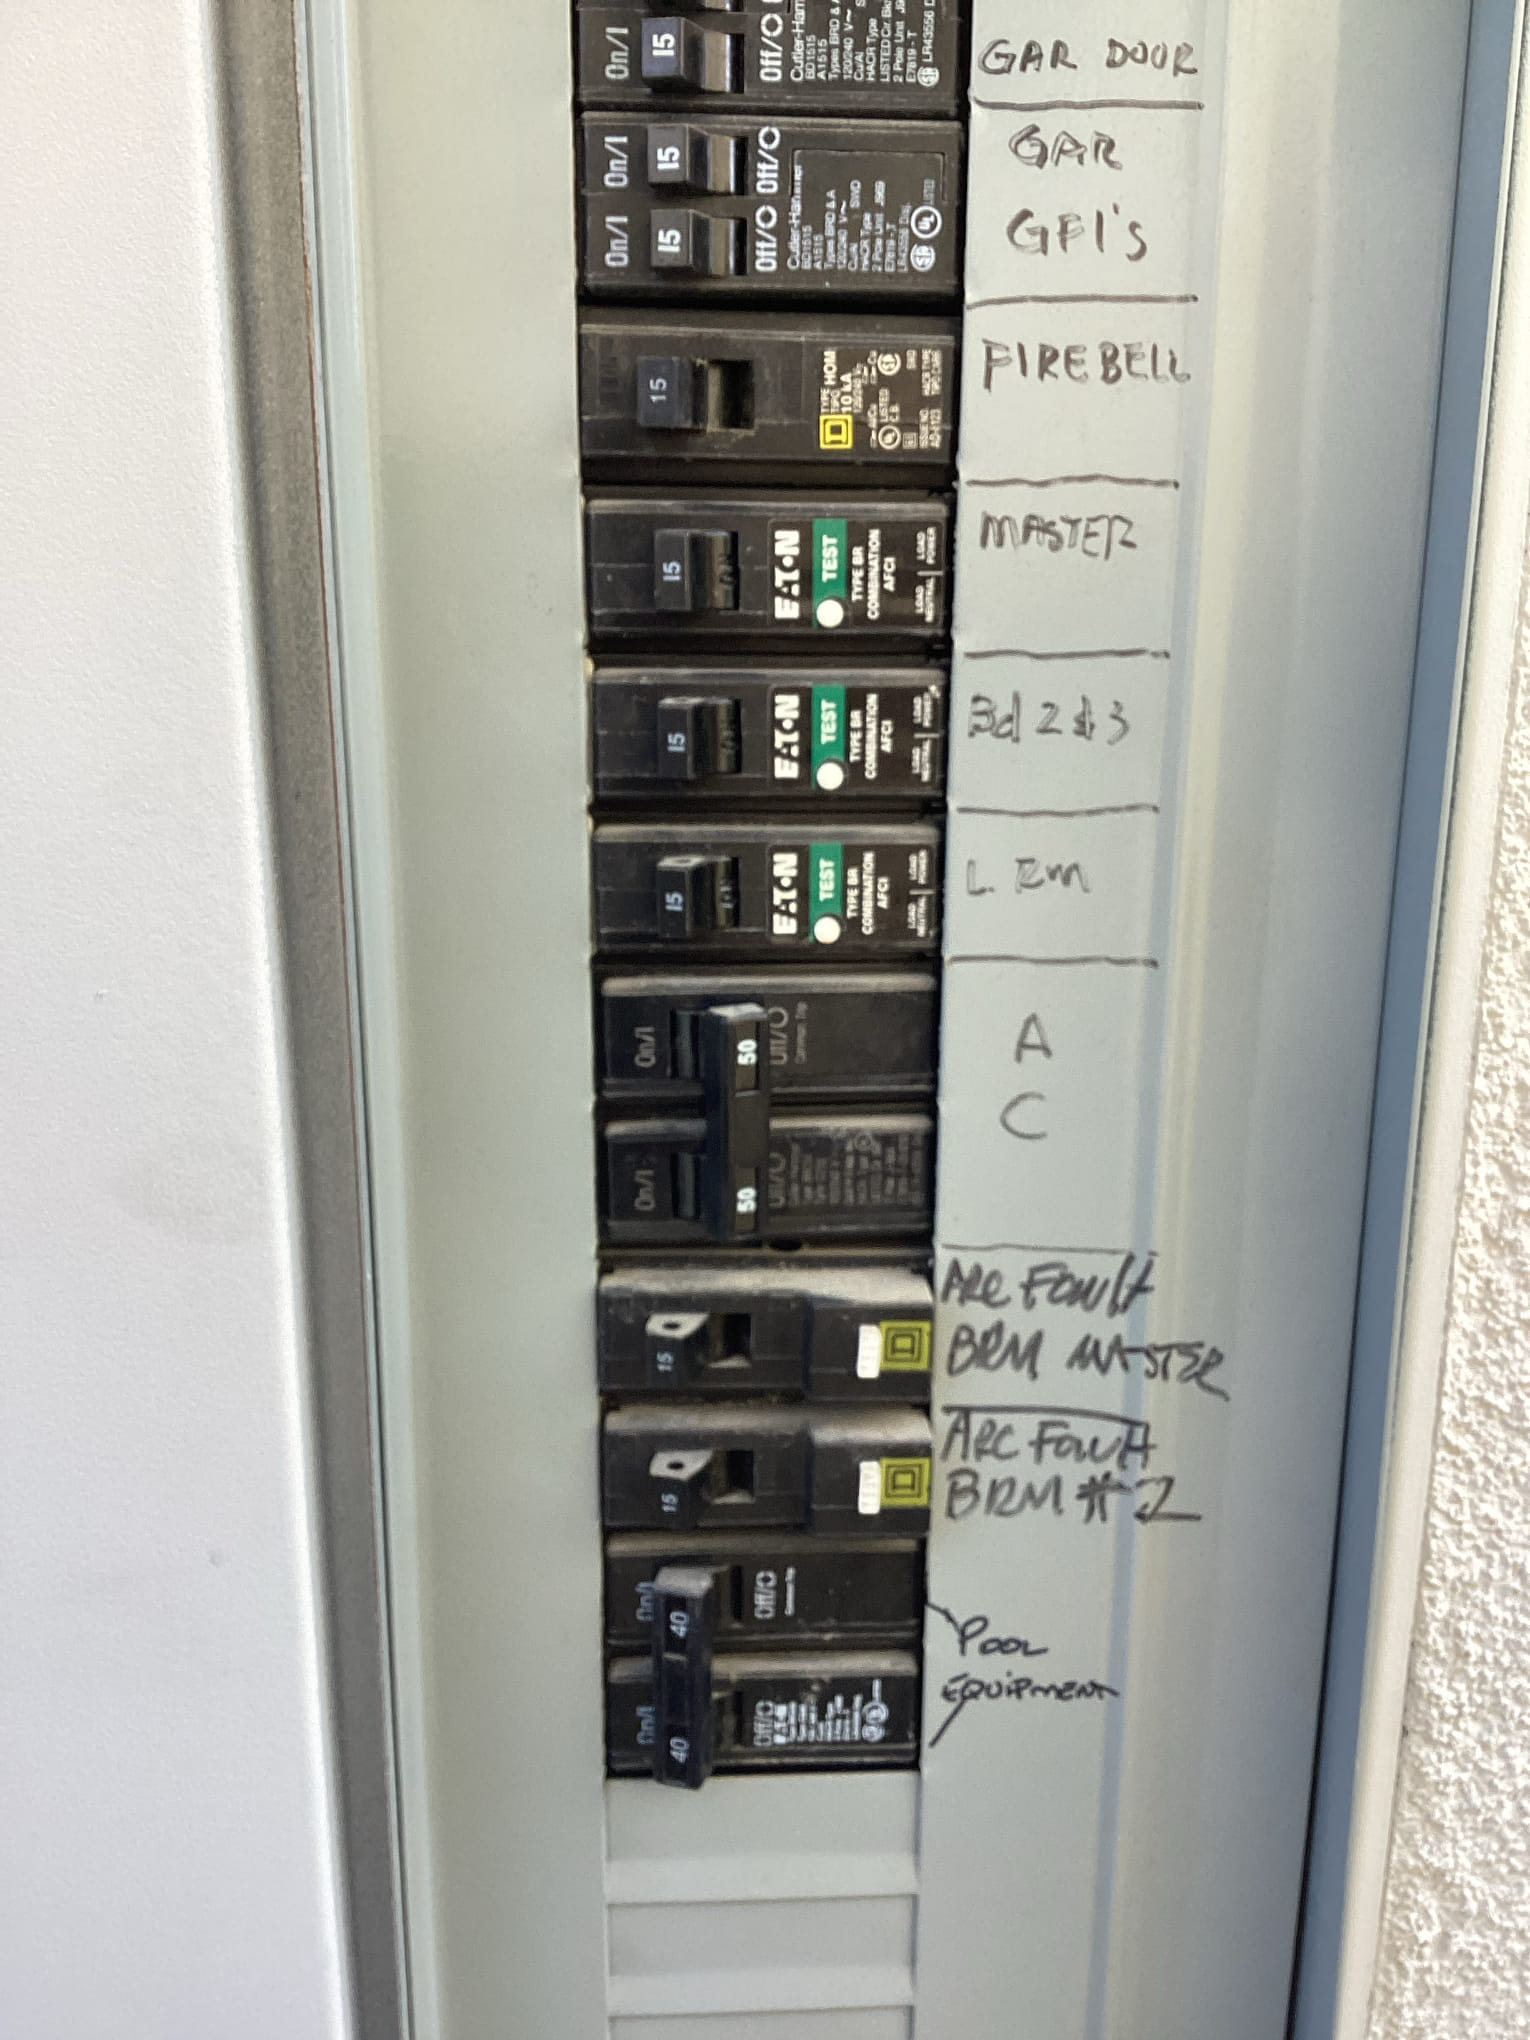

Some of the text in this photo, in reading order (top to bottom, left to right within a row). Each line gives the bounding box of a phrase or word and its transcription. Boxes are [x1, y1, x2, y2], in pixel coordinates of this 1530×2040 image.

[652, 33, 675, 57] 15
[829, 19, 840, 45] BRD
[894, 21, 905, 43] Unit
[817, 39, 828, 81] A1515
[828, 48, 840, 82] Types
[866, 18, 878, 81] HACR Type
[880, 40, 891, 82] LISTED
[893, 47, 904, 71] Pole
[978, 38, 1198, 77] GAR DOOR
[893, 74, 904, 82] 2
[657, 146, 680, 170] 15
[1009, 124, 1122, 170] GAR
[657, 228, 681, 253] 15
[823, 351, 837, 385] HOM
[649, 378, 667, 402] 15
[841, 395, 852, 413] 10
[979, 511, 1138, 560] MASTER
[662, 561, 682, 582] 15
[822, 534, 838, 582] TEST
[867, 528, 880, 620] COMBINATION
[883, 557, 896, 592] AFCI
[852, 568, 864, 602] TYPE
[821, 699, 837, 745] TEST
[865, 693, 879, 779] COMBINATION
[881, 720, 894, 753] AFCI
[1036, 701, 1063, 735] 2
[1107, 701, 1129, 745] 3
[667, 731, 687, 752] 15
[850, 730, 862, 762] TYPE
[819, 858, 835, 902] TEST
[861, 852, 876, 935] COMBINATION
[877, 877, 890, 909] AFCI
[665, 892, 685, 911] 15
[846, 888, 859, 919] TYPE
[737, 1040, 758, 1066] 50
[1014, 1012, 1053, 1064] A
[999, 1091, 1048, 1140] C
[736, 1187, 757, 1213] 50
[656, 1351, 674, 1372] 15
[1066, 1333, 1230, 1402] MASTER
[661, 1493, 679, 1512] 15
[945, 1467, 1063, 1521] BRM
[670, 1611, 689, 1637] 40
[670, 1737, 689, 1763] 40
